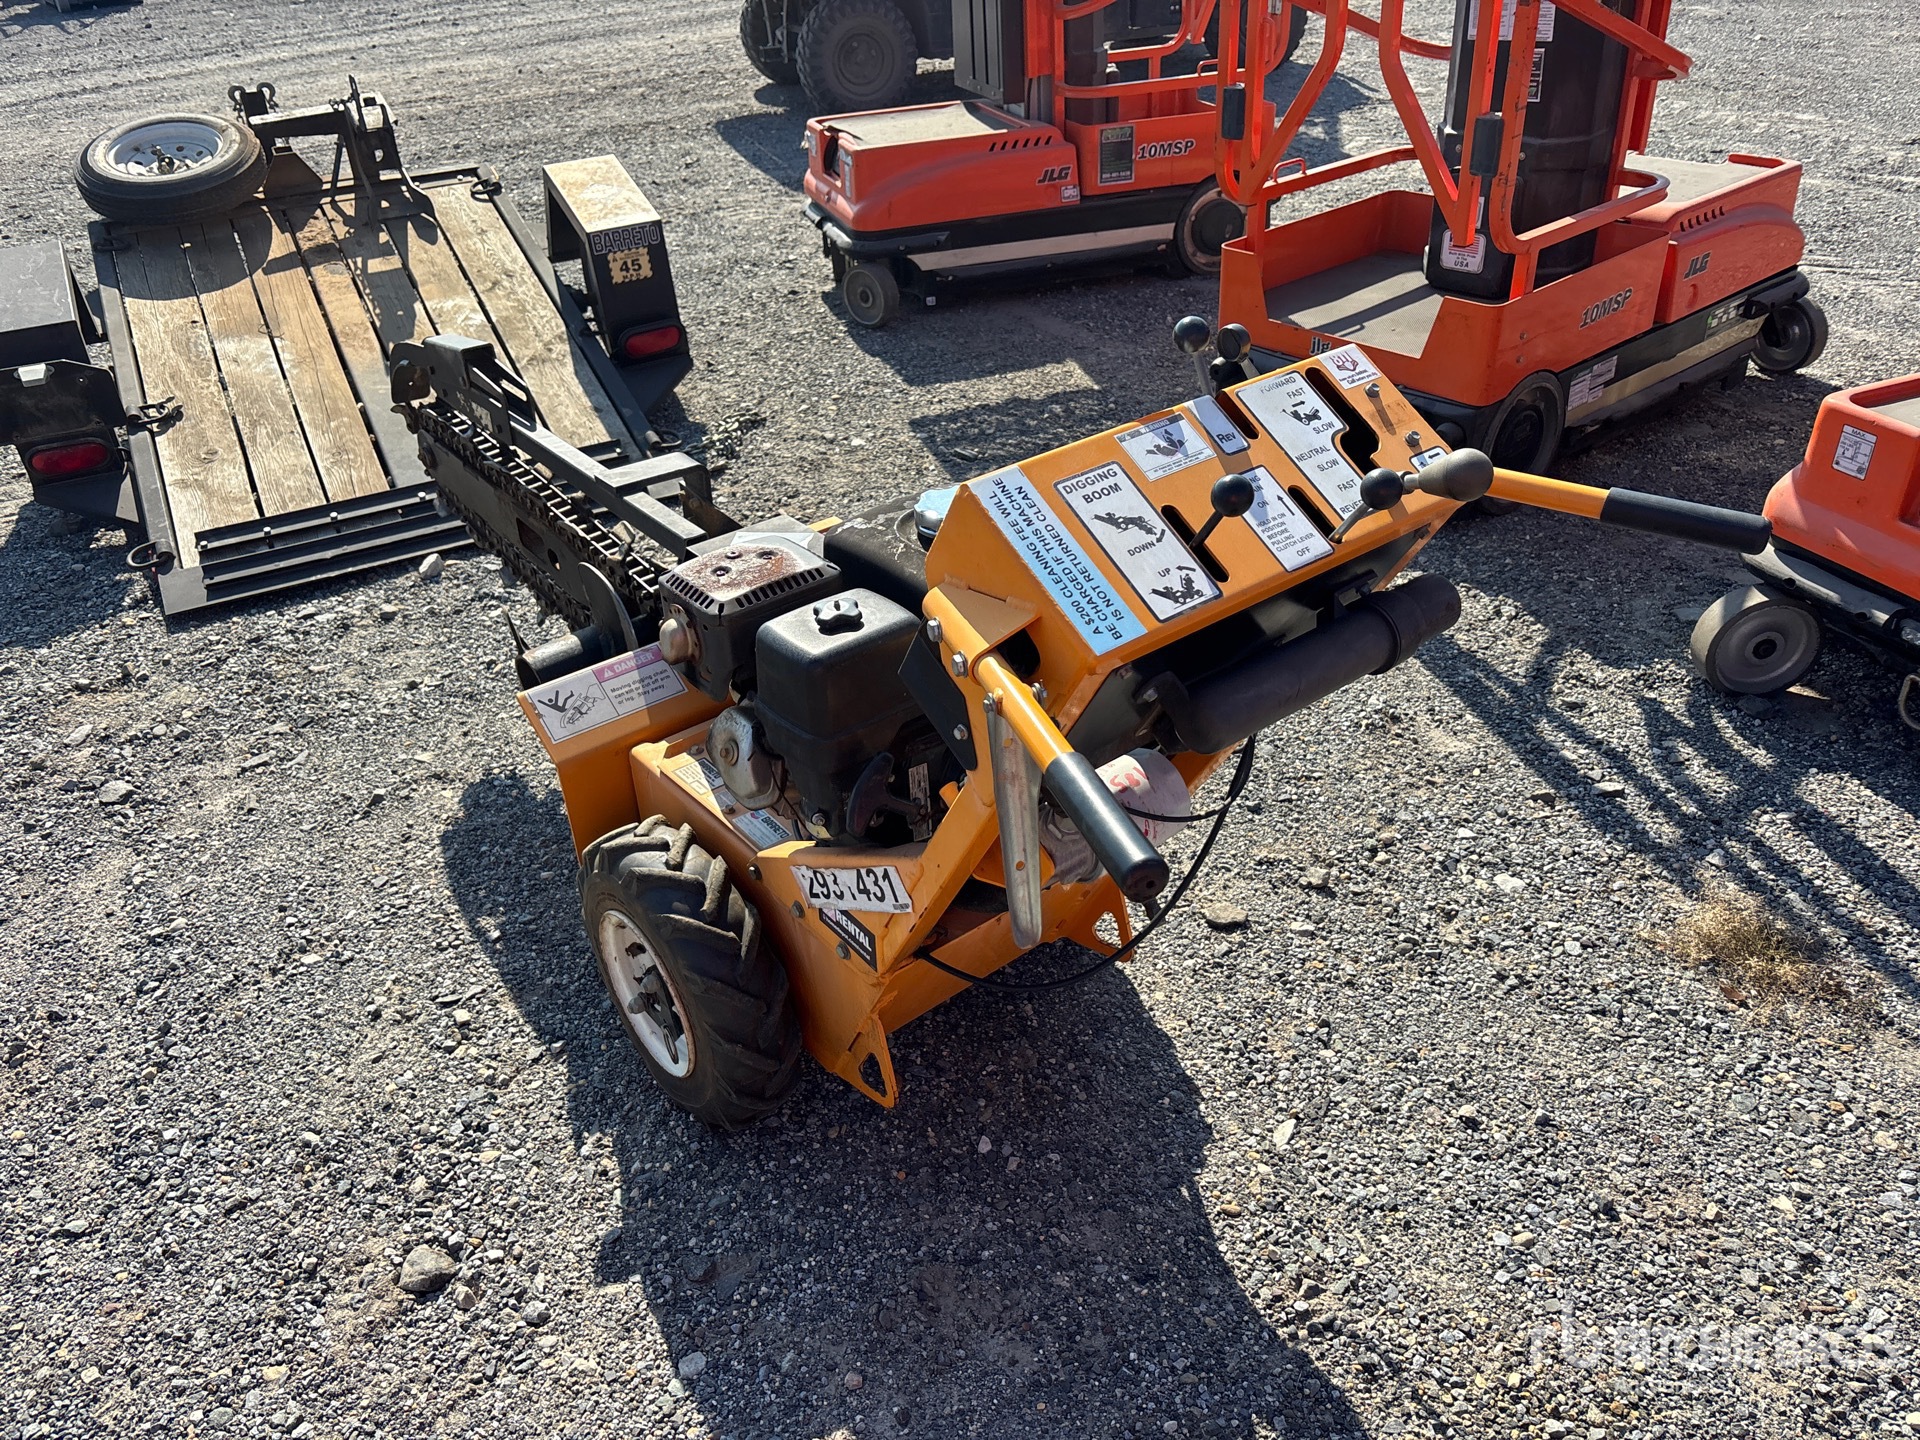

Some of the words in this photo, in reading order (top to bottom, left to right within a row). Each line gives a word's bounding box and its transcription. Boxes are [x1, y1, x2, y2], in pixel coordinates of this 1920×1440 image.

[1137, 139, 1195, 160] 10MSP
[1037, 165, 1072, 185] JLG
[591, 224, 660, 254] BARRETO
[620, 259, 642, 273] 45
[1454, 260, 1469, 268] USA
[1683, 251, 1712, 281] JLG
[1579, 287, 1633, 330] 10MSP
[1260, 376, 1297, 394] FORWARD
[1286, 387, 1306, 399] FAST
[1140, 419, 1171, 434] WARNING
[1312, 421, 1336, 435] SLOW
[1295, 445, 1331, 463] NEUTRAL
[1316, 458, 1340, 472] SLOW
[1062, 467, 1118, 495] DIGGING
[1337, 479, 1358, 492] FAST
[992, 477, 1035, 527] MACHINE
[1082, 482, 1123, 504] BOOM
[989, 491, 1012, 518] WILL
[1014, 485, 1047, 523] CLEAN
[1257, 500, 1270, 509] ON
[1339, 500, 1363, 515] REVE
[1255, 518, 1271, 528] HOLD
[1277, 512, 1287, 520] ON
[1260, 520, 1287, 534] POSITION
[1008, 518, 1029, 541] FEE
[1266, 527, 1290, 541] BEFORE
[1031, 528, 1055, 554] THIS
[1127, 540, 1157, 557] DOWN
[1270, 533, 1295, 547] PULLING
[1275, 540, 1298, 552] CLUTCH
[1298, 532, 1315, 543] LEVER
[1044, 523, 1095, 583] RETURNED
[1296, 546, 1311, 557] OFF
[1051, 555, 1065, 567] IF
[1026, 543, 1074, 599] CLEANING
[1157, 567, 1172, 579] UP
[1061, 567, 1108, 622] CHARGED
[1091, 585, 1114, 608] NOT
[1071, 600, 1095, 626] $200
[1111, 608, 1125, 622] IS
[1092, 627, 1104, 635] A
[1105, 622, 1123, 641] BE
[614, 653, 654, 672] DANGER
[610, 683, 631, 693] Moving
[632, 674, 653, 686] digging
[652, 668, 668, 678] chain
[626, 687, 634, 695] kill
[641, 681, 651, 689] cut
[650, 677, 660, 686] off
[638, 688, 650, 697] Stay
[650, 684, 665, 693] away
[761, 816, 790, 839] BARRETO
[836, 911, 873, 952] RENTAL
